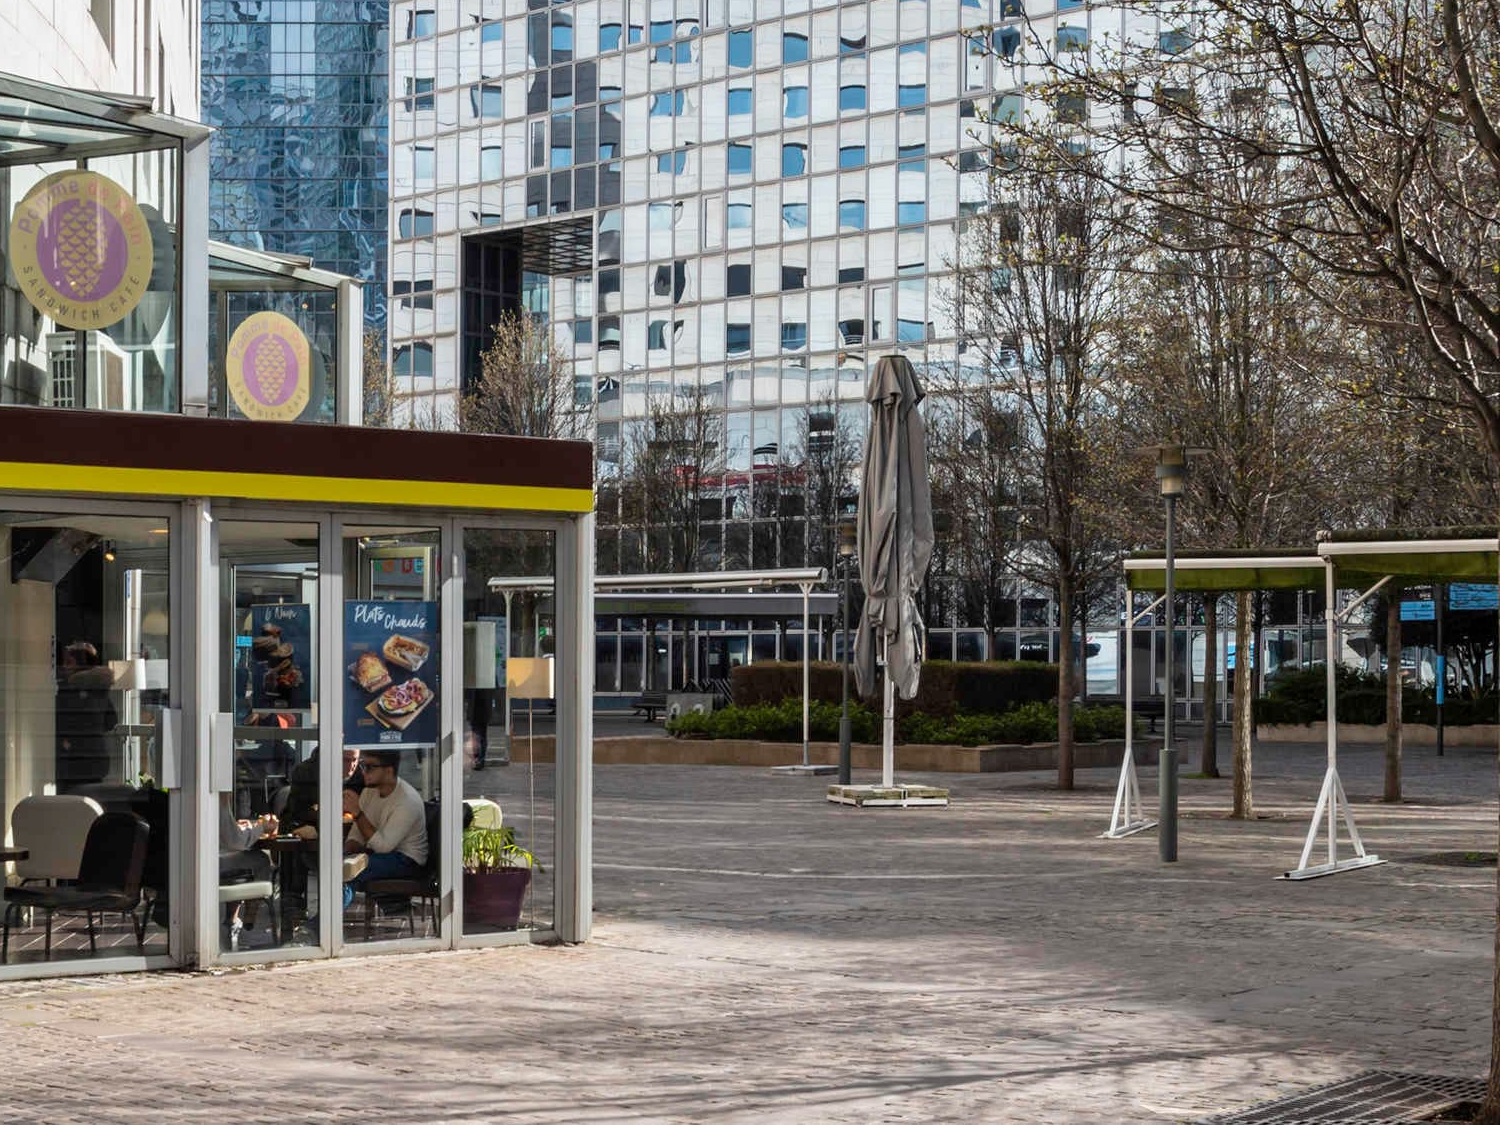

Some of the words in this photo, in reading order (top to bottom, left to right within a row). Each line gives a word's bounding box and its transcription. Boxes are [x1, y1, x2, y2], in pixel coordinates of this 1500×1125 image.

[23, 266, 100, 321] SANDWICH
[354, 604, 385, 623] Plats
[384, 614, 427, 630] Chauds
